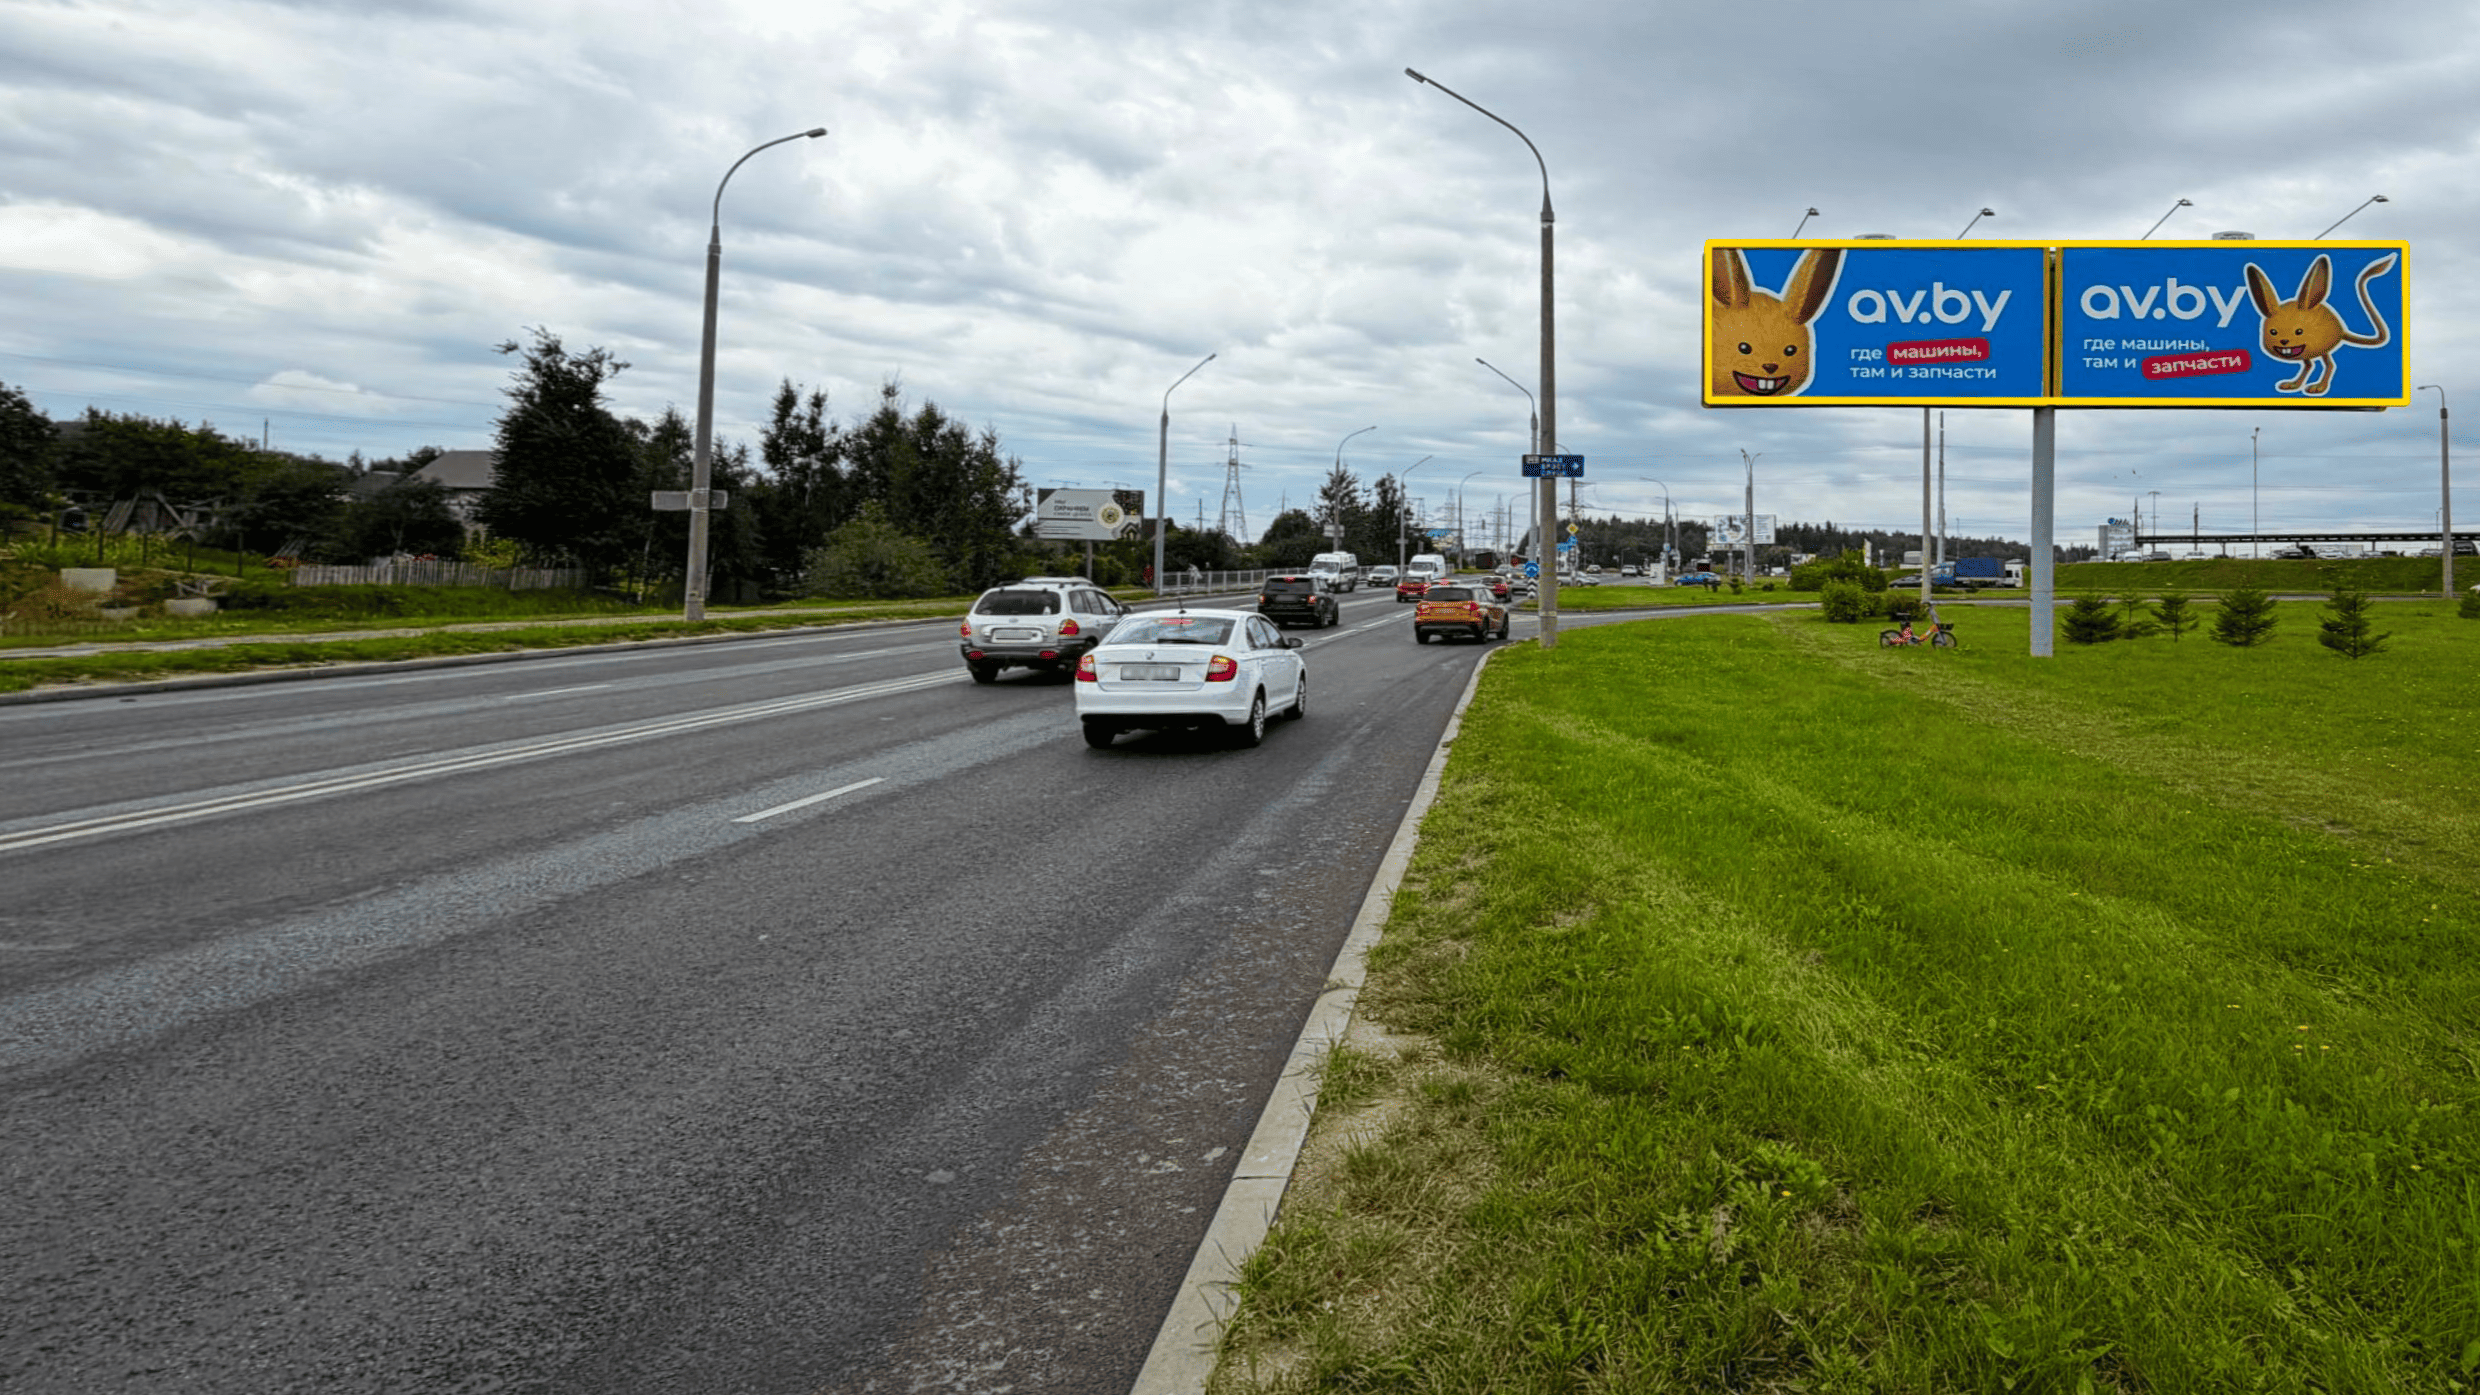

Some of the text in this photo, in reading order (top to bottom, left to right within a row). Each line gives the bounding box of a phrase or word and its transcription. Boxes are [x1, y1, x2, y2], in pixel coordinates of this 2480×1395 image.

[1848, 282, 2013, 332] av.by
[2080, 277, 2248, 328] av.by
[1850, 345, 1982, 361] где машины,
[2083, 339, 2210, 352] где машины,
[1850, 367, 1997, 379] там и запчасти
[2082, 355, 2242, 374] там и запчасти
